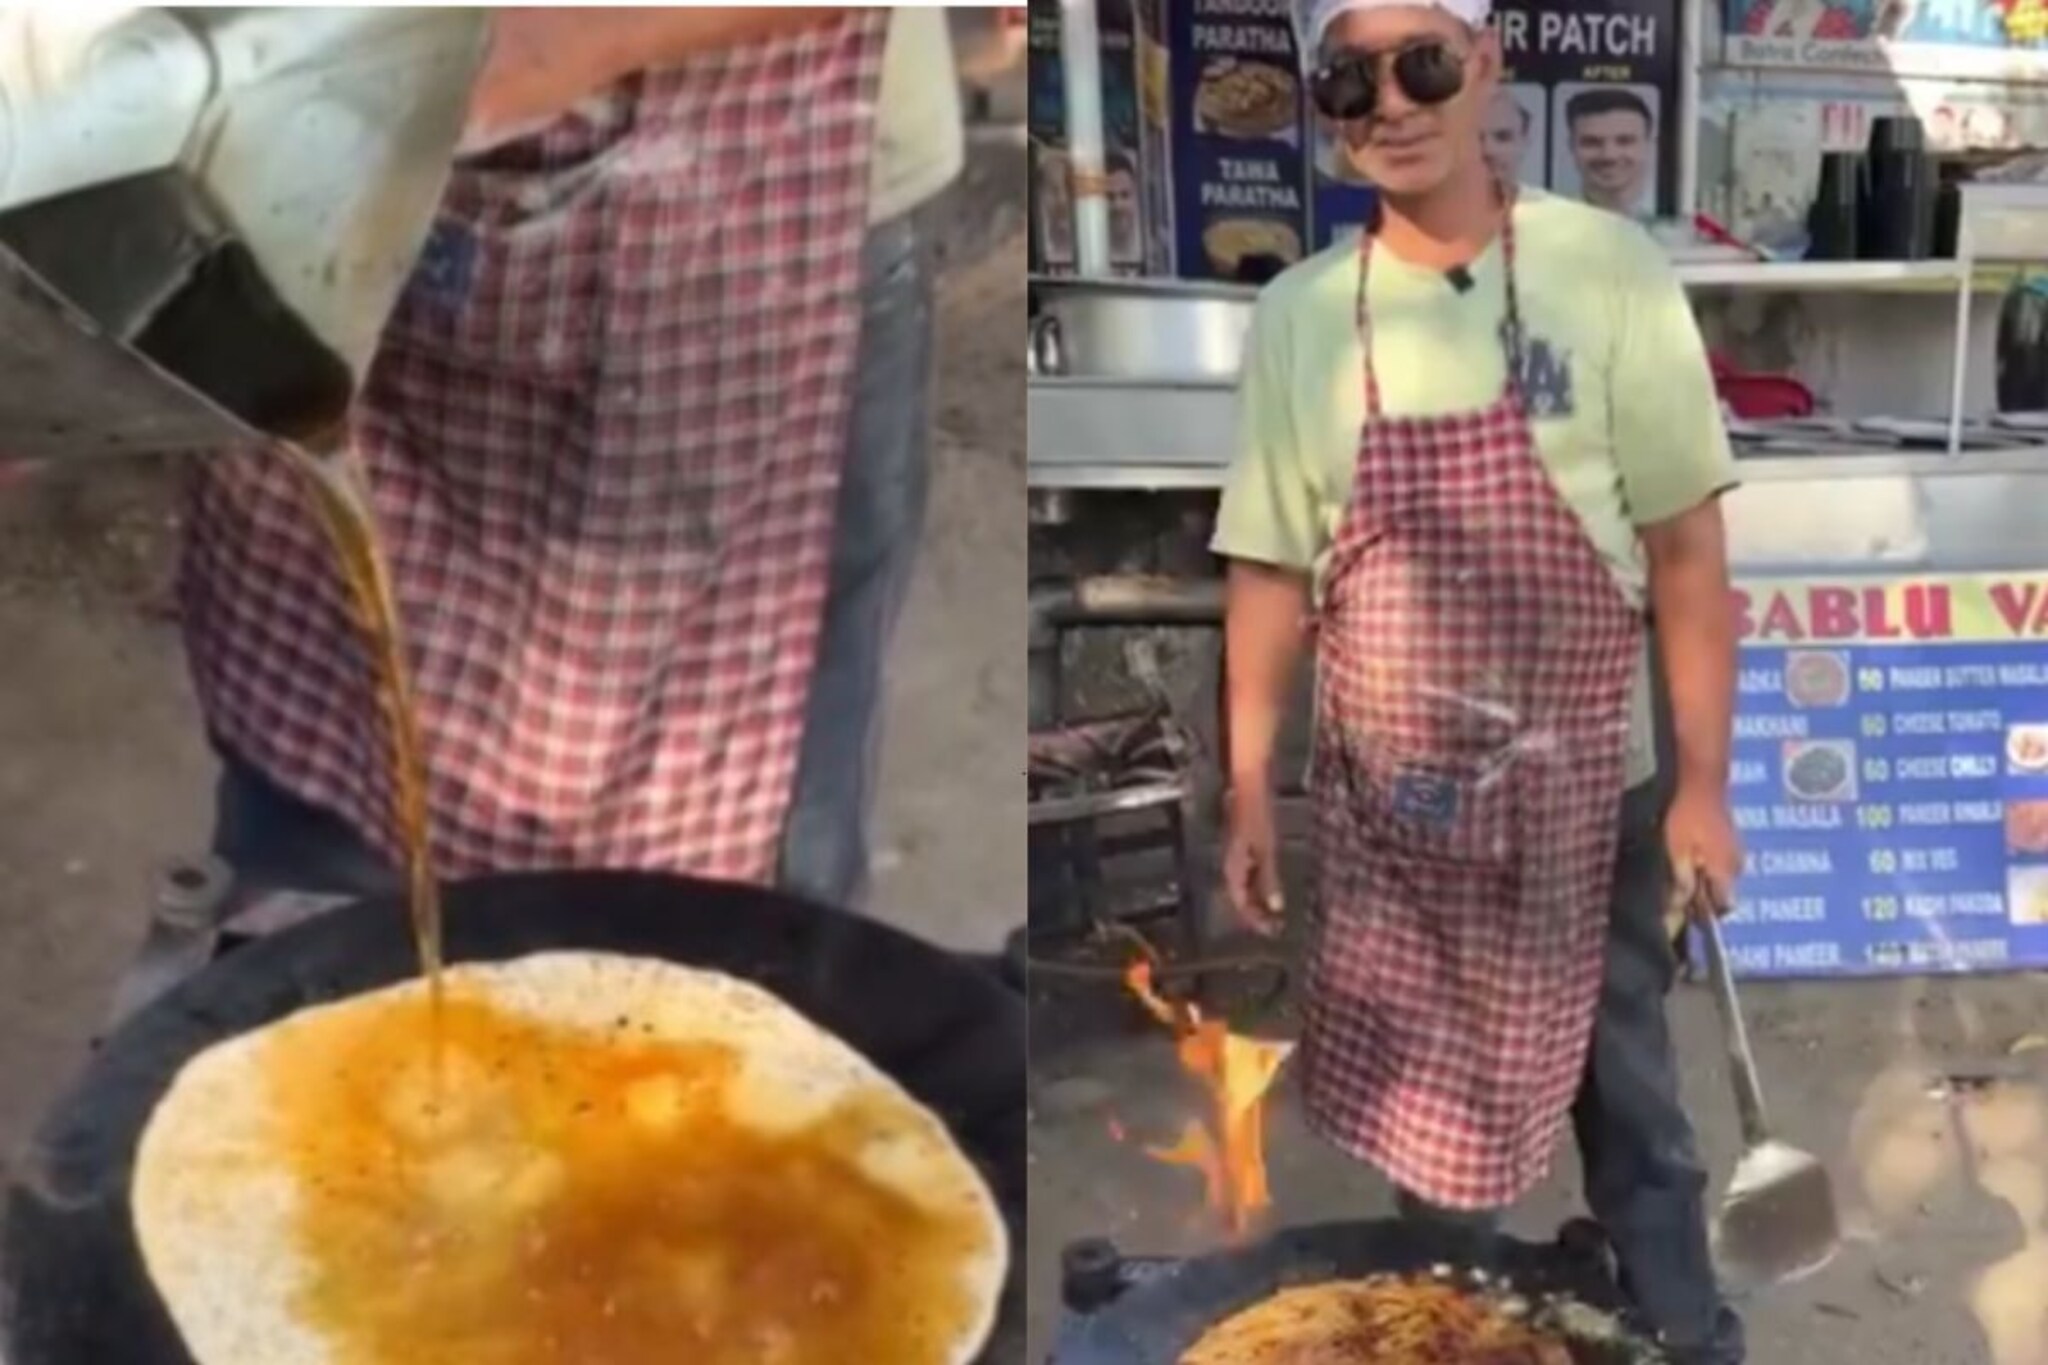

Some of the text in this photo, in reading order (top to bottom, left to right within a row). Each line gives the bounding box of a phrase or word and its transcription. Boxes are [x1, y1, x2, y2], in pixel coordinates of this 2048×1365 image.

[1192, 23, 1292, 54] PARATHA
[1538, 10, 1656, 55] PATCH
[1582, 65, 1631, 80] AFTER
[1218, 157, 1280, 182] TAWA
[1200, 182, 1299, 210] PARATHA
[1861, 895, 1899, 922] 120
